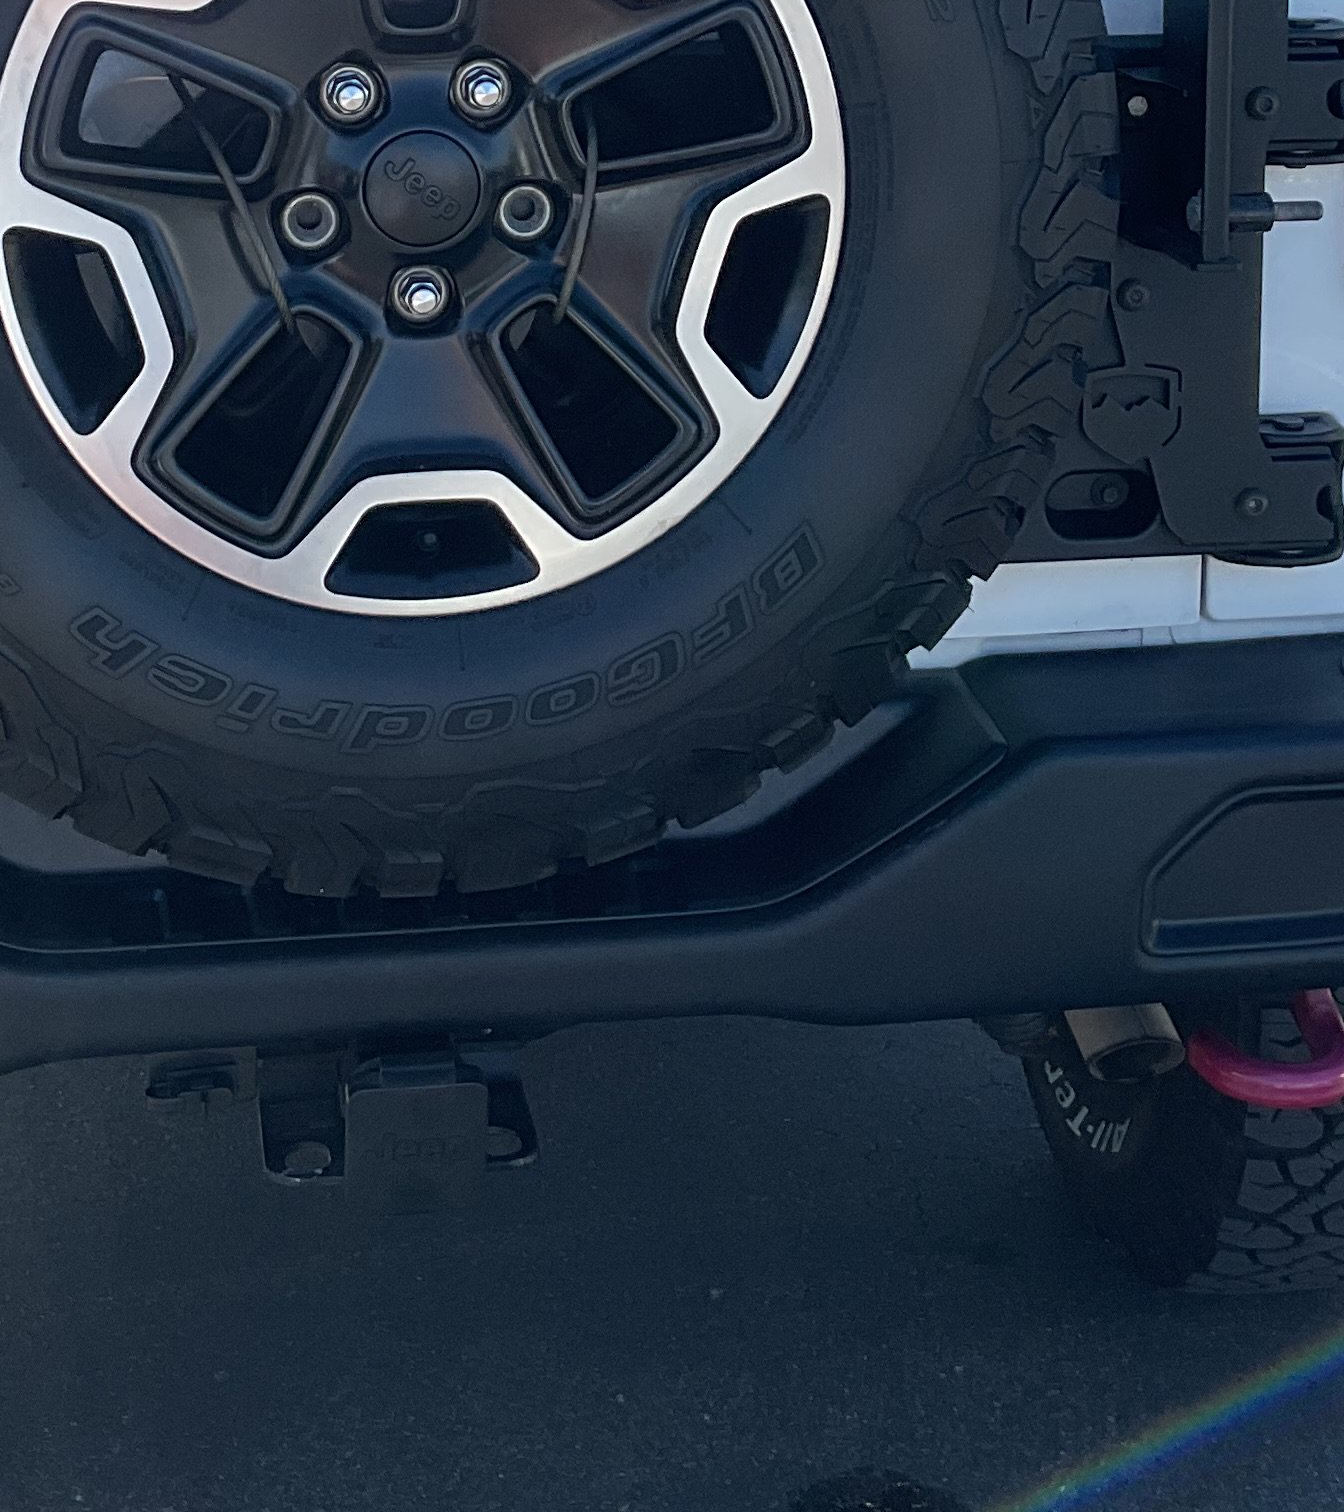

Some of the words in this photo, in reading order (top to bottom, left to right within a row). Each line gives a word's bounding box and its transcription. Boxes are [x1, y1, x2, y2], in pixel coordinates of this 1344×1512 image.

[384, 157, 461, 220] Jeep
[69, 521, 829, 754] BFGoodrich
[1044, 1060, 1132, 1153] All-Ter
